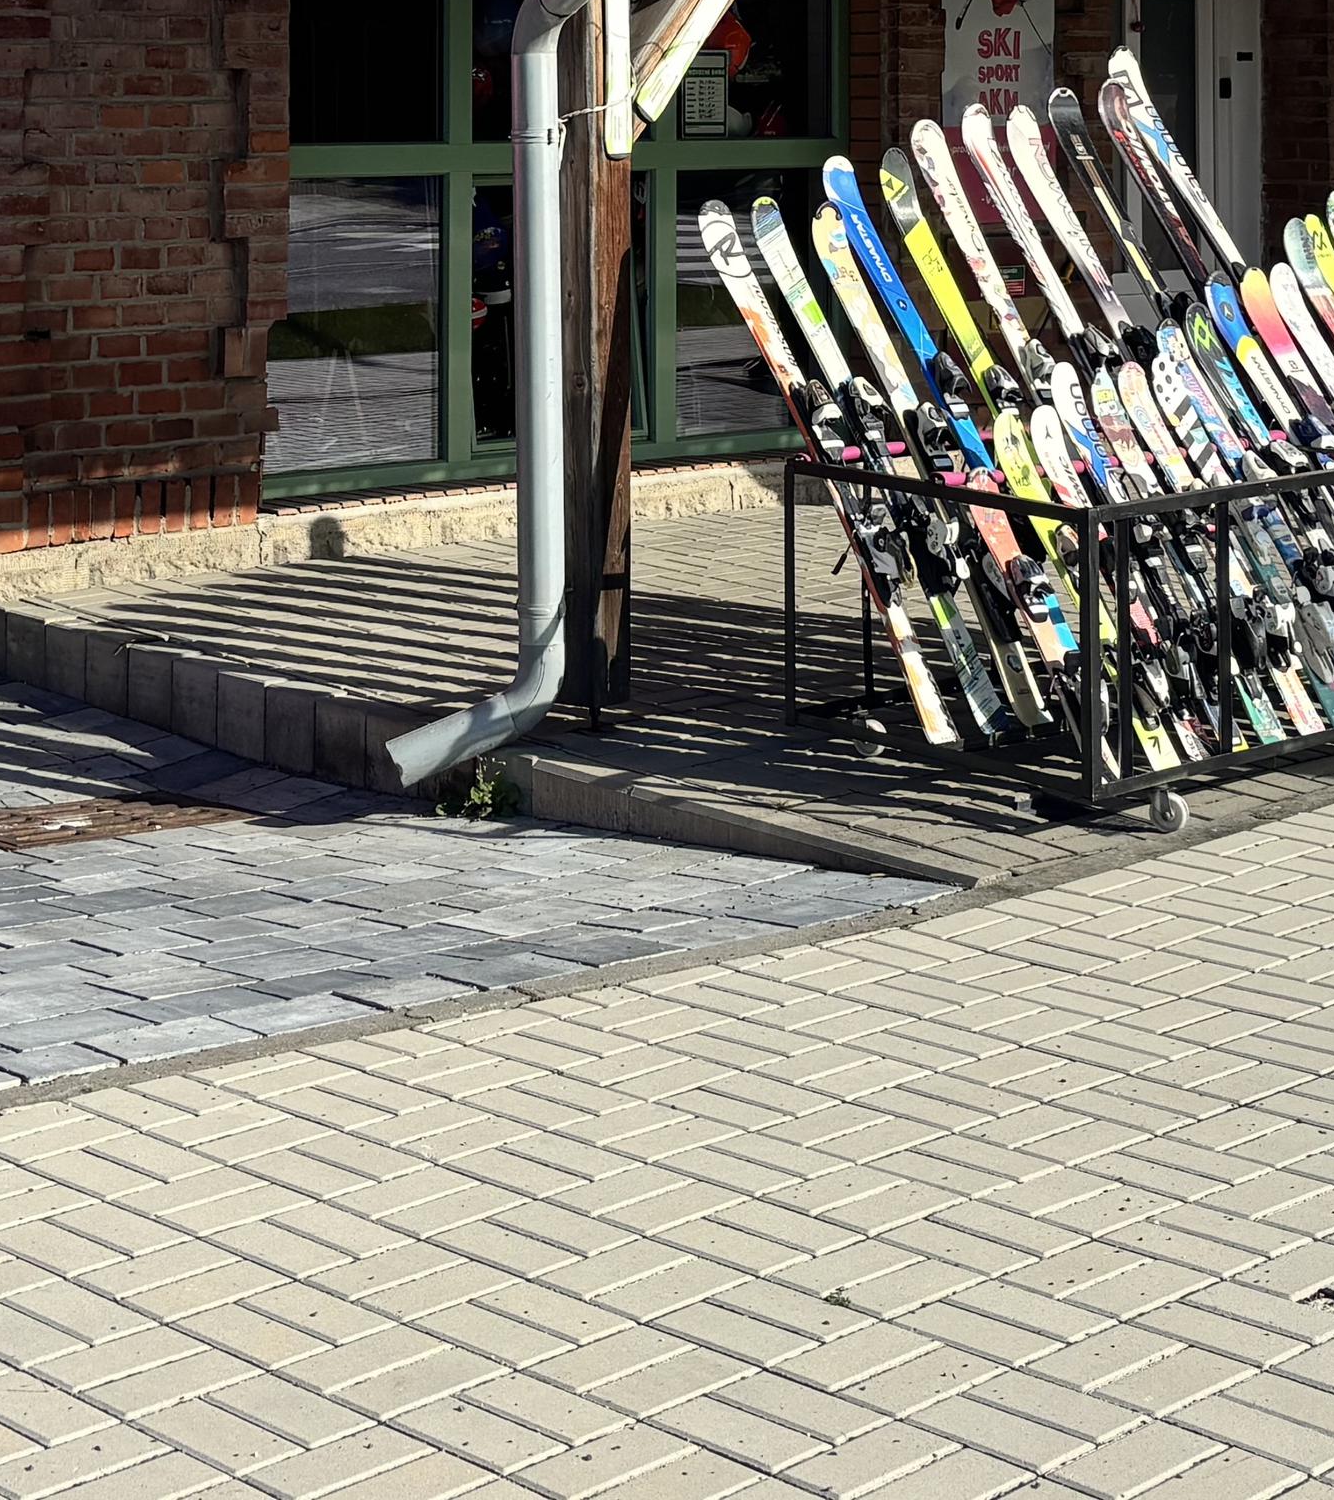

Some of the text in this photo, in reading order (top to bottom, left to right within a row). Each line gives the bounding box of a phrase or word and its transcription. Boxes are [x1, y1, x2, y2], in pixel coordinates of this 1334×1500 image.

[977, 27, 1021, 60] SKI
[978, 64, 1020, 84] SPORT
[978, 88, 1019, 116] AKM
[1121, 119, 1181, 219] ATOMIC
[946, 175, 987, 252] Dynastar
[850, 213, 894, 284] DYNASTAR
[1251, 355, 1292, 414] DYNASTAR
